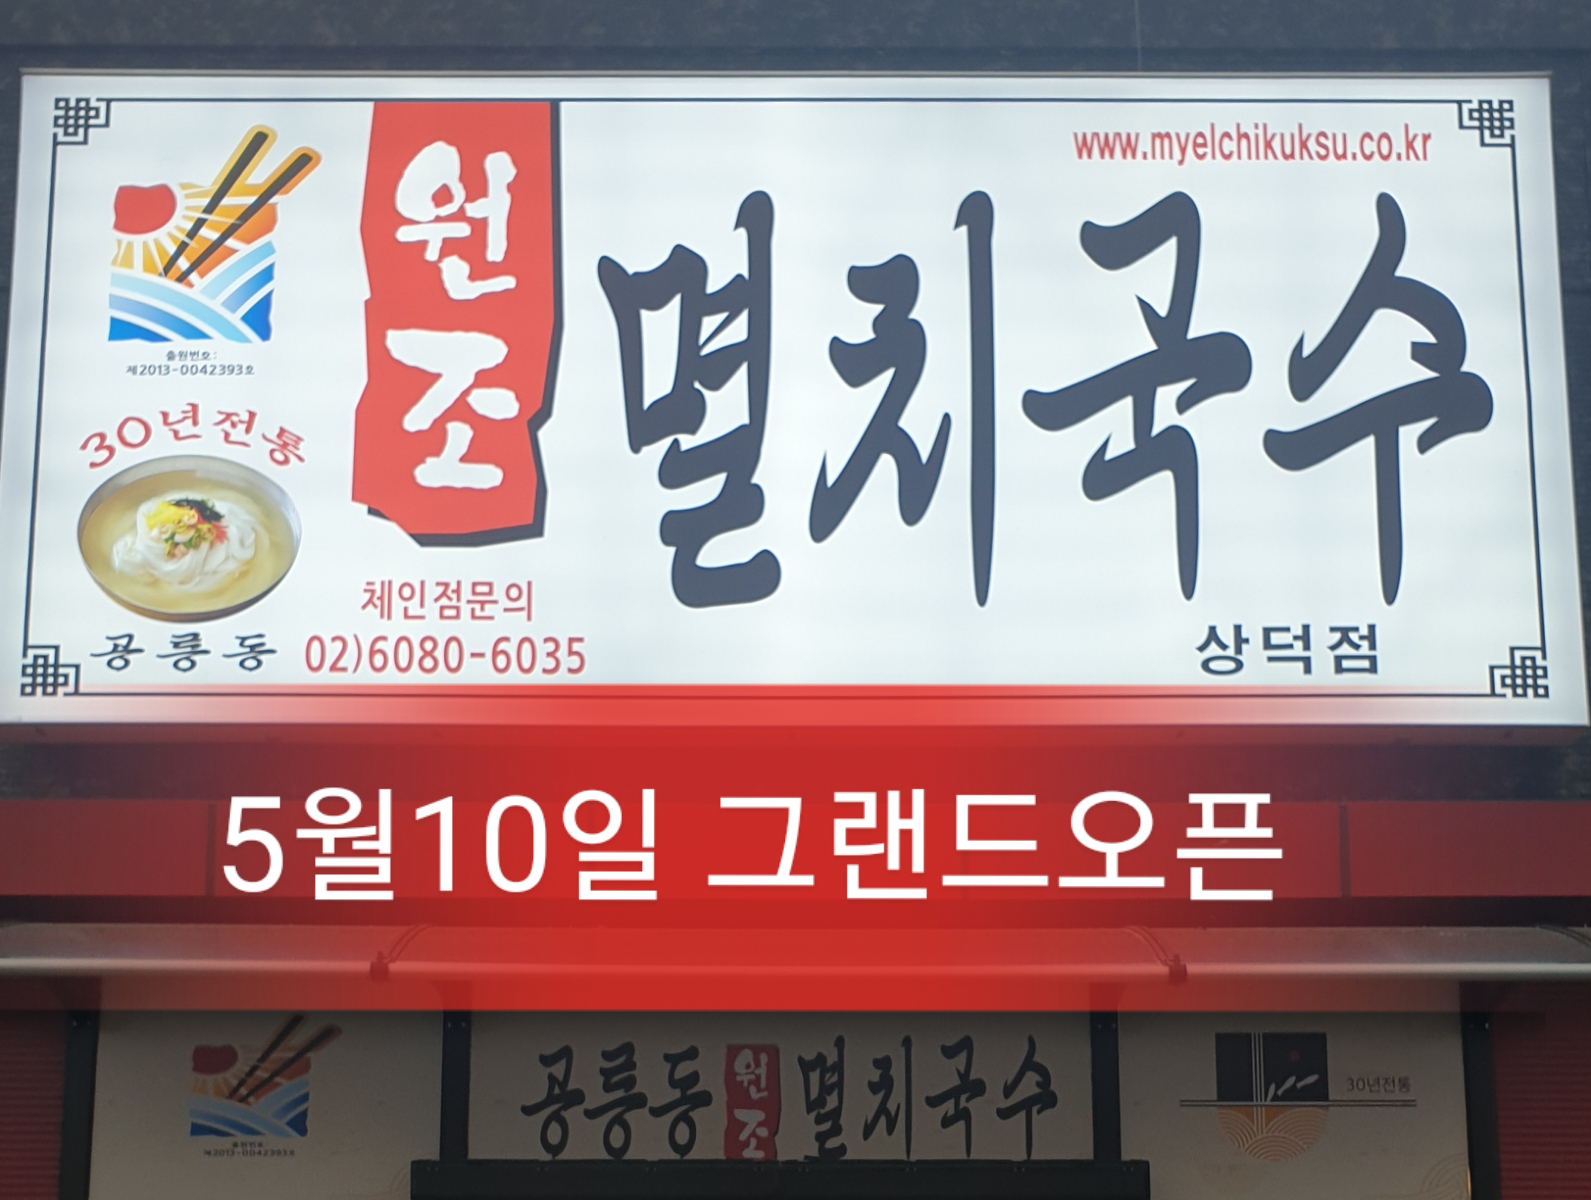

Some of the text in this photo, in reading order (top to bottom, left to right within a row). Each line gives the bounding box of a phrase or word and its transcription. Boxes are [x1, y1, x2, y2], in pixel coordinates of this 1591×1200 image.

[1073, 124, 1432, 167] www.myelchikuksu.co.kr
[126, 364, 255, 377] 제2013-0042393호
[385, 140, 1494, 609] 원조 멸치국수
[79, 403, 306, 469] 30년전통
[361, 580, 533, 622] 체인점문의
[90, 632, 278, 673] 공릉동
[304, 635, 587, 676] 02)6080-6035
[1196, 623, 1380, 675] 상덕점
[520, 1034, 1059, 1159] 공릉동 원조 멸치국수
[1346, 1075, 1412, 1094] 30년전통
